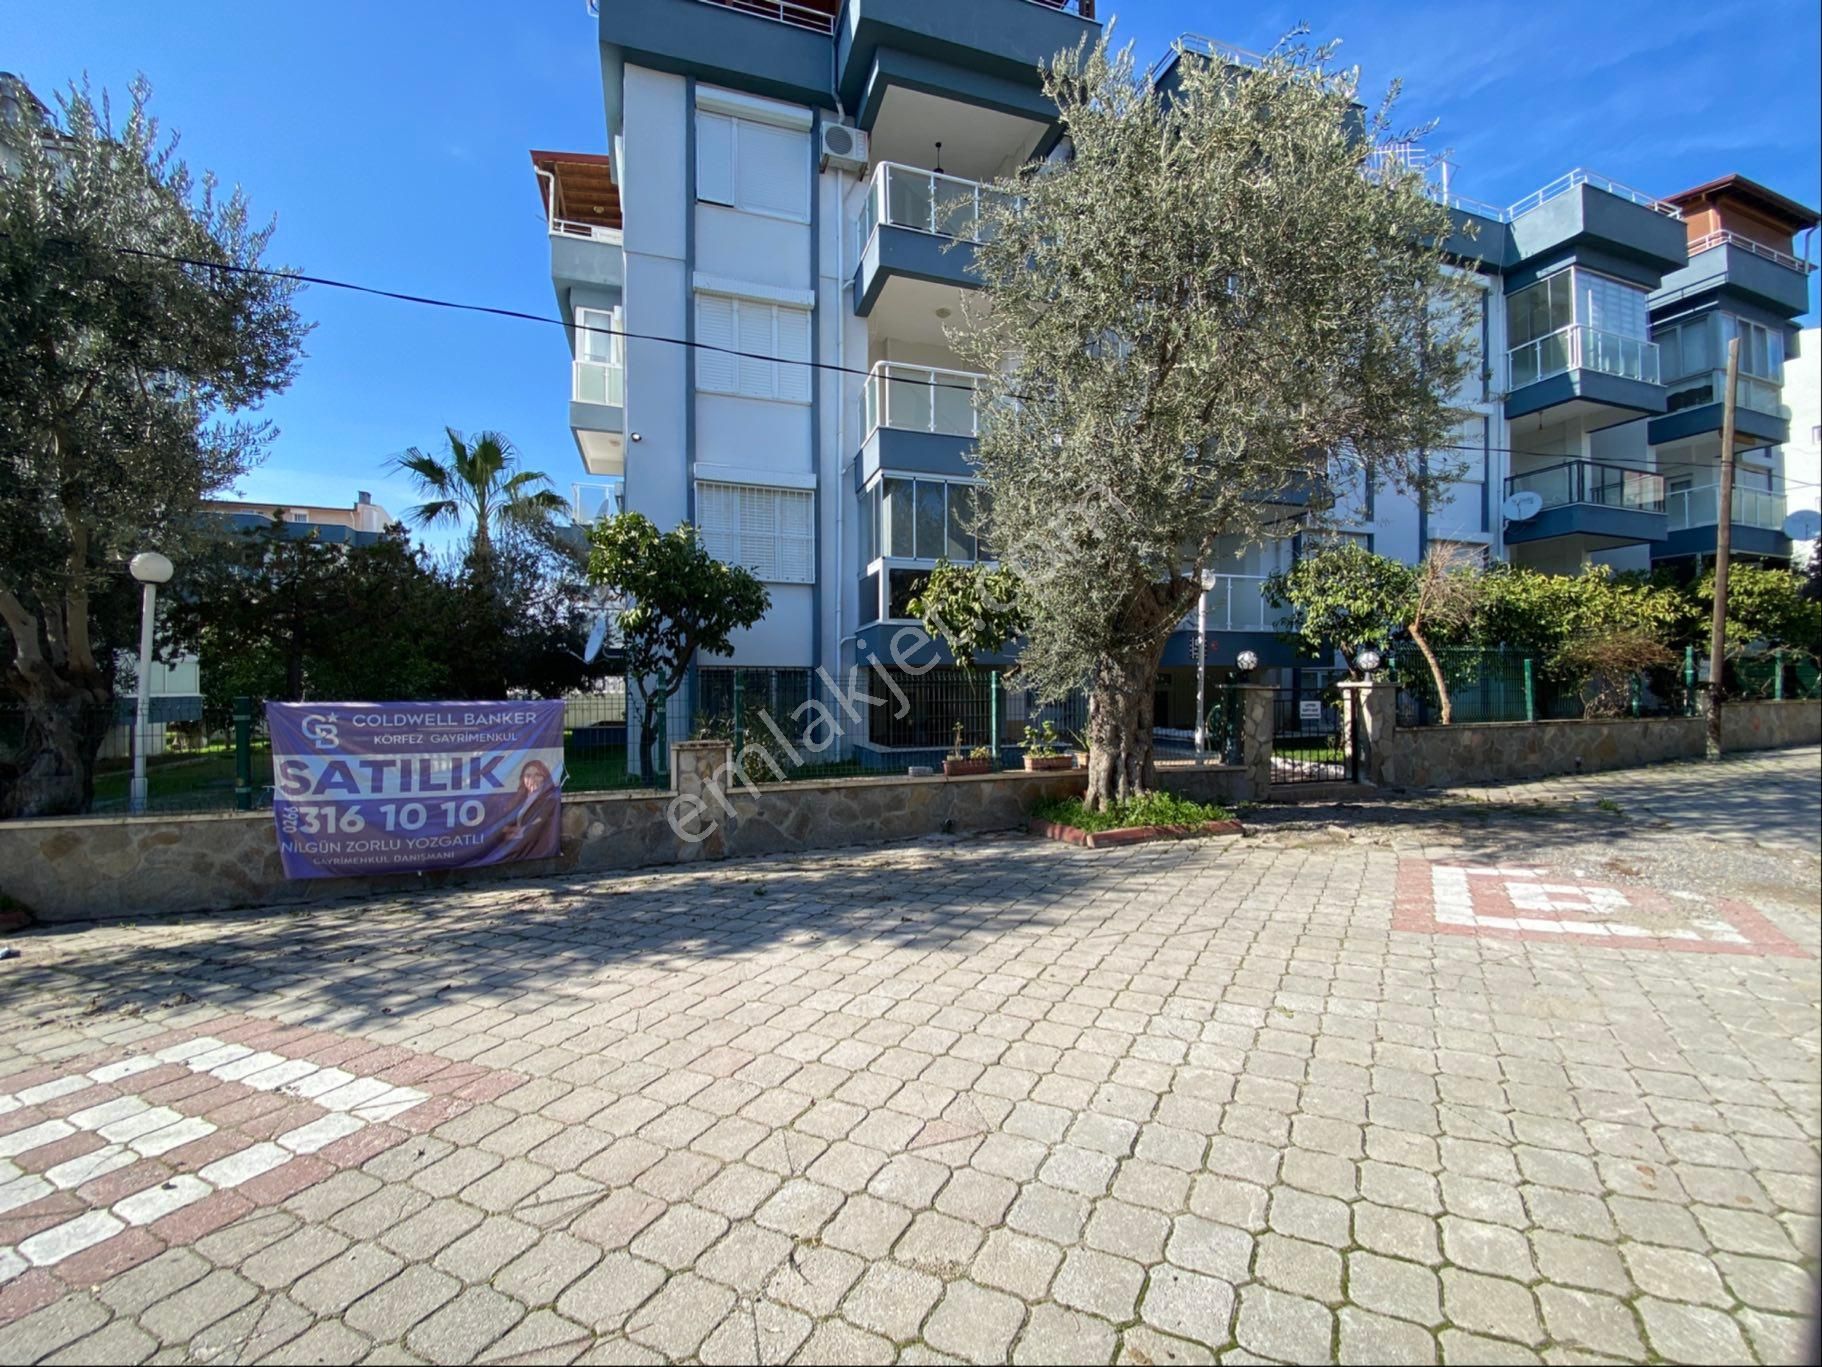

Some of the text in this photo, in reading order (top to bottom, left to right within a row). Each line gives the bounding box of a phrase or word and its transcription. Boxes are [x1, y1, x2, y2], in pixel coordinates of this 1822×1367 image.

[353, 711, 537, 728] COLDWELL BANKER
[374, 730, 519, 745] KÖRFEZ GAYRİMENKUL
[280, 755, 505, 797] SATILIK
[299, 805, 366, 834] 316
[379, 802, 427, 832] 10
[441, 799, 486, 828] 10
[281, 833, 485, 855] NİLGÜN ZORLU YOZGATLI
